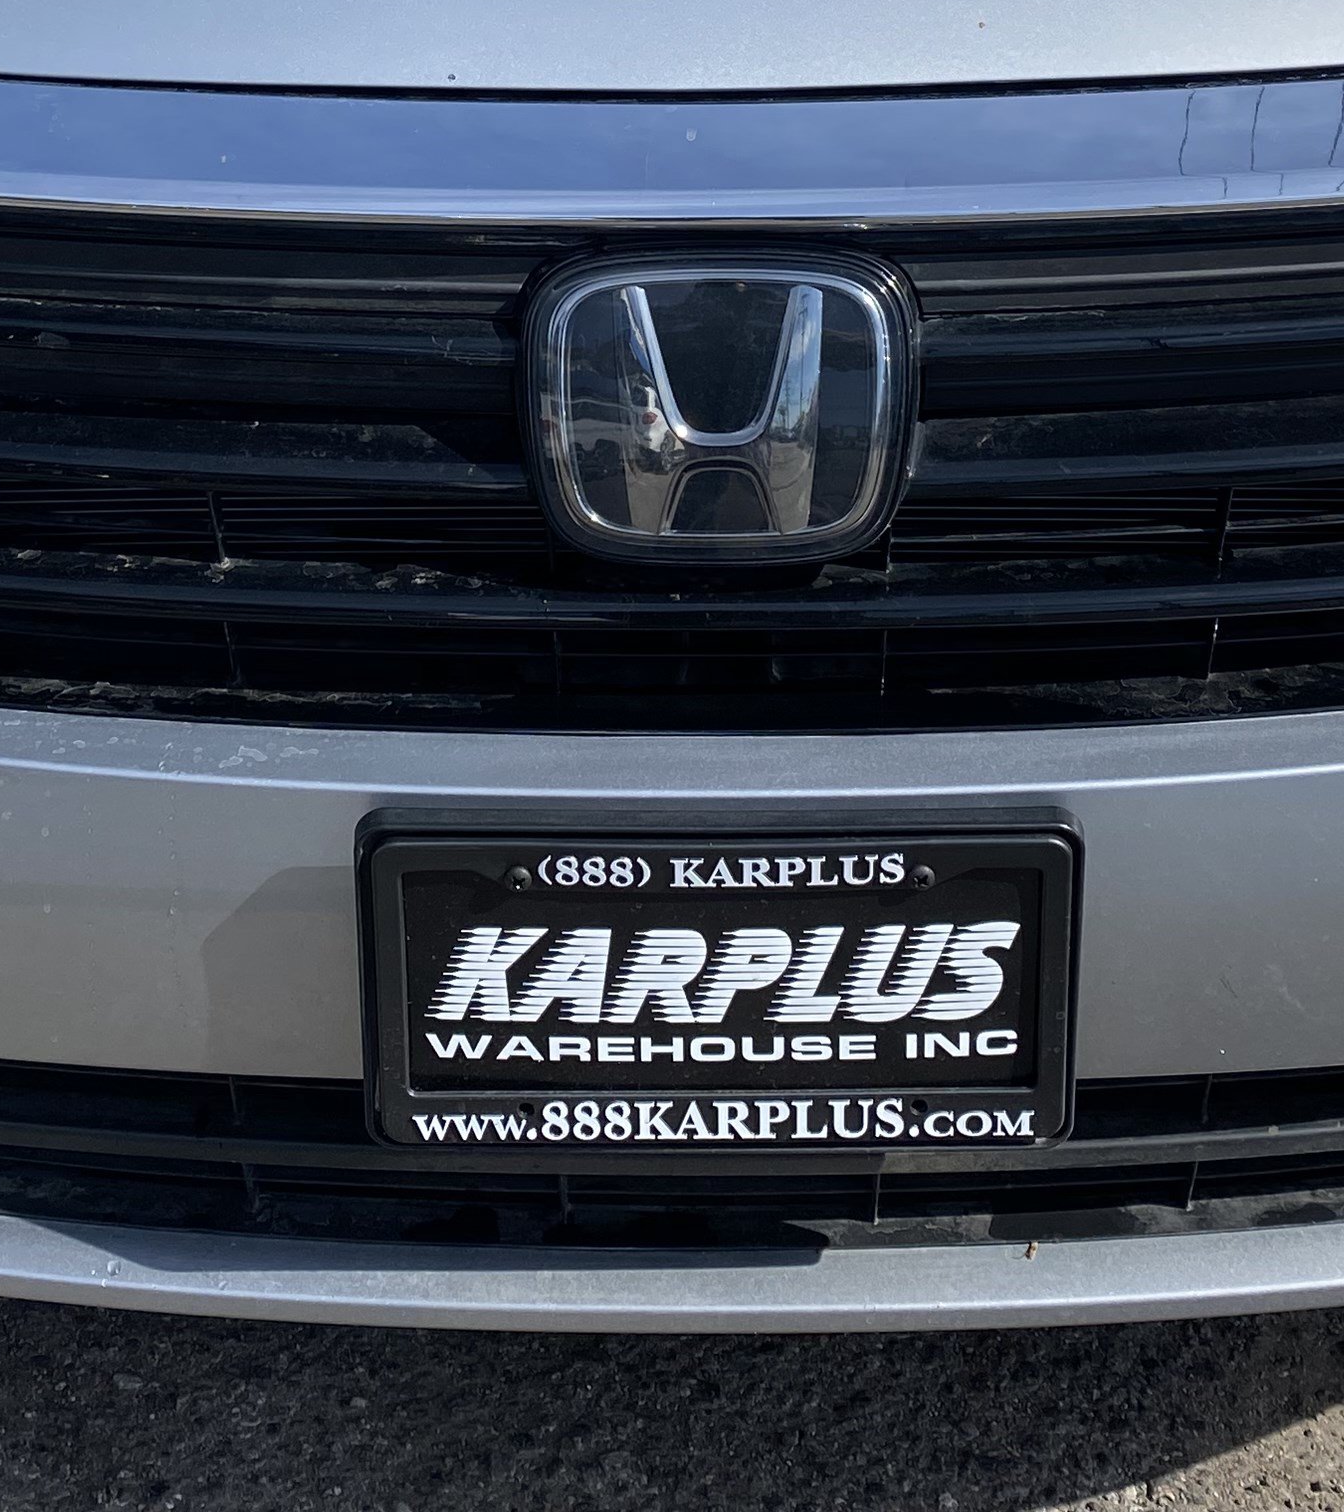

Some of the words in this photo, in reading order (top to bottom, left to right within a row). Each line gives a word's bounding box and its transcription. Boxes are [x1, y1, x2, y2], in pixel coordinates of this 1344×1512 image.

[537, 853, 652, 890] (888)
[670, 852, 905, 888] KARPLUS
[424, 920, 1022, 1025] KARPLUS
[424, 1031, 877, 1064] WAREHOUSE
[905, 1029, 1019, 1059] INC
